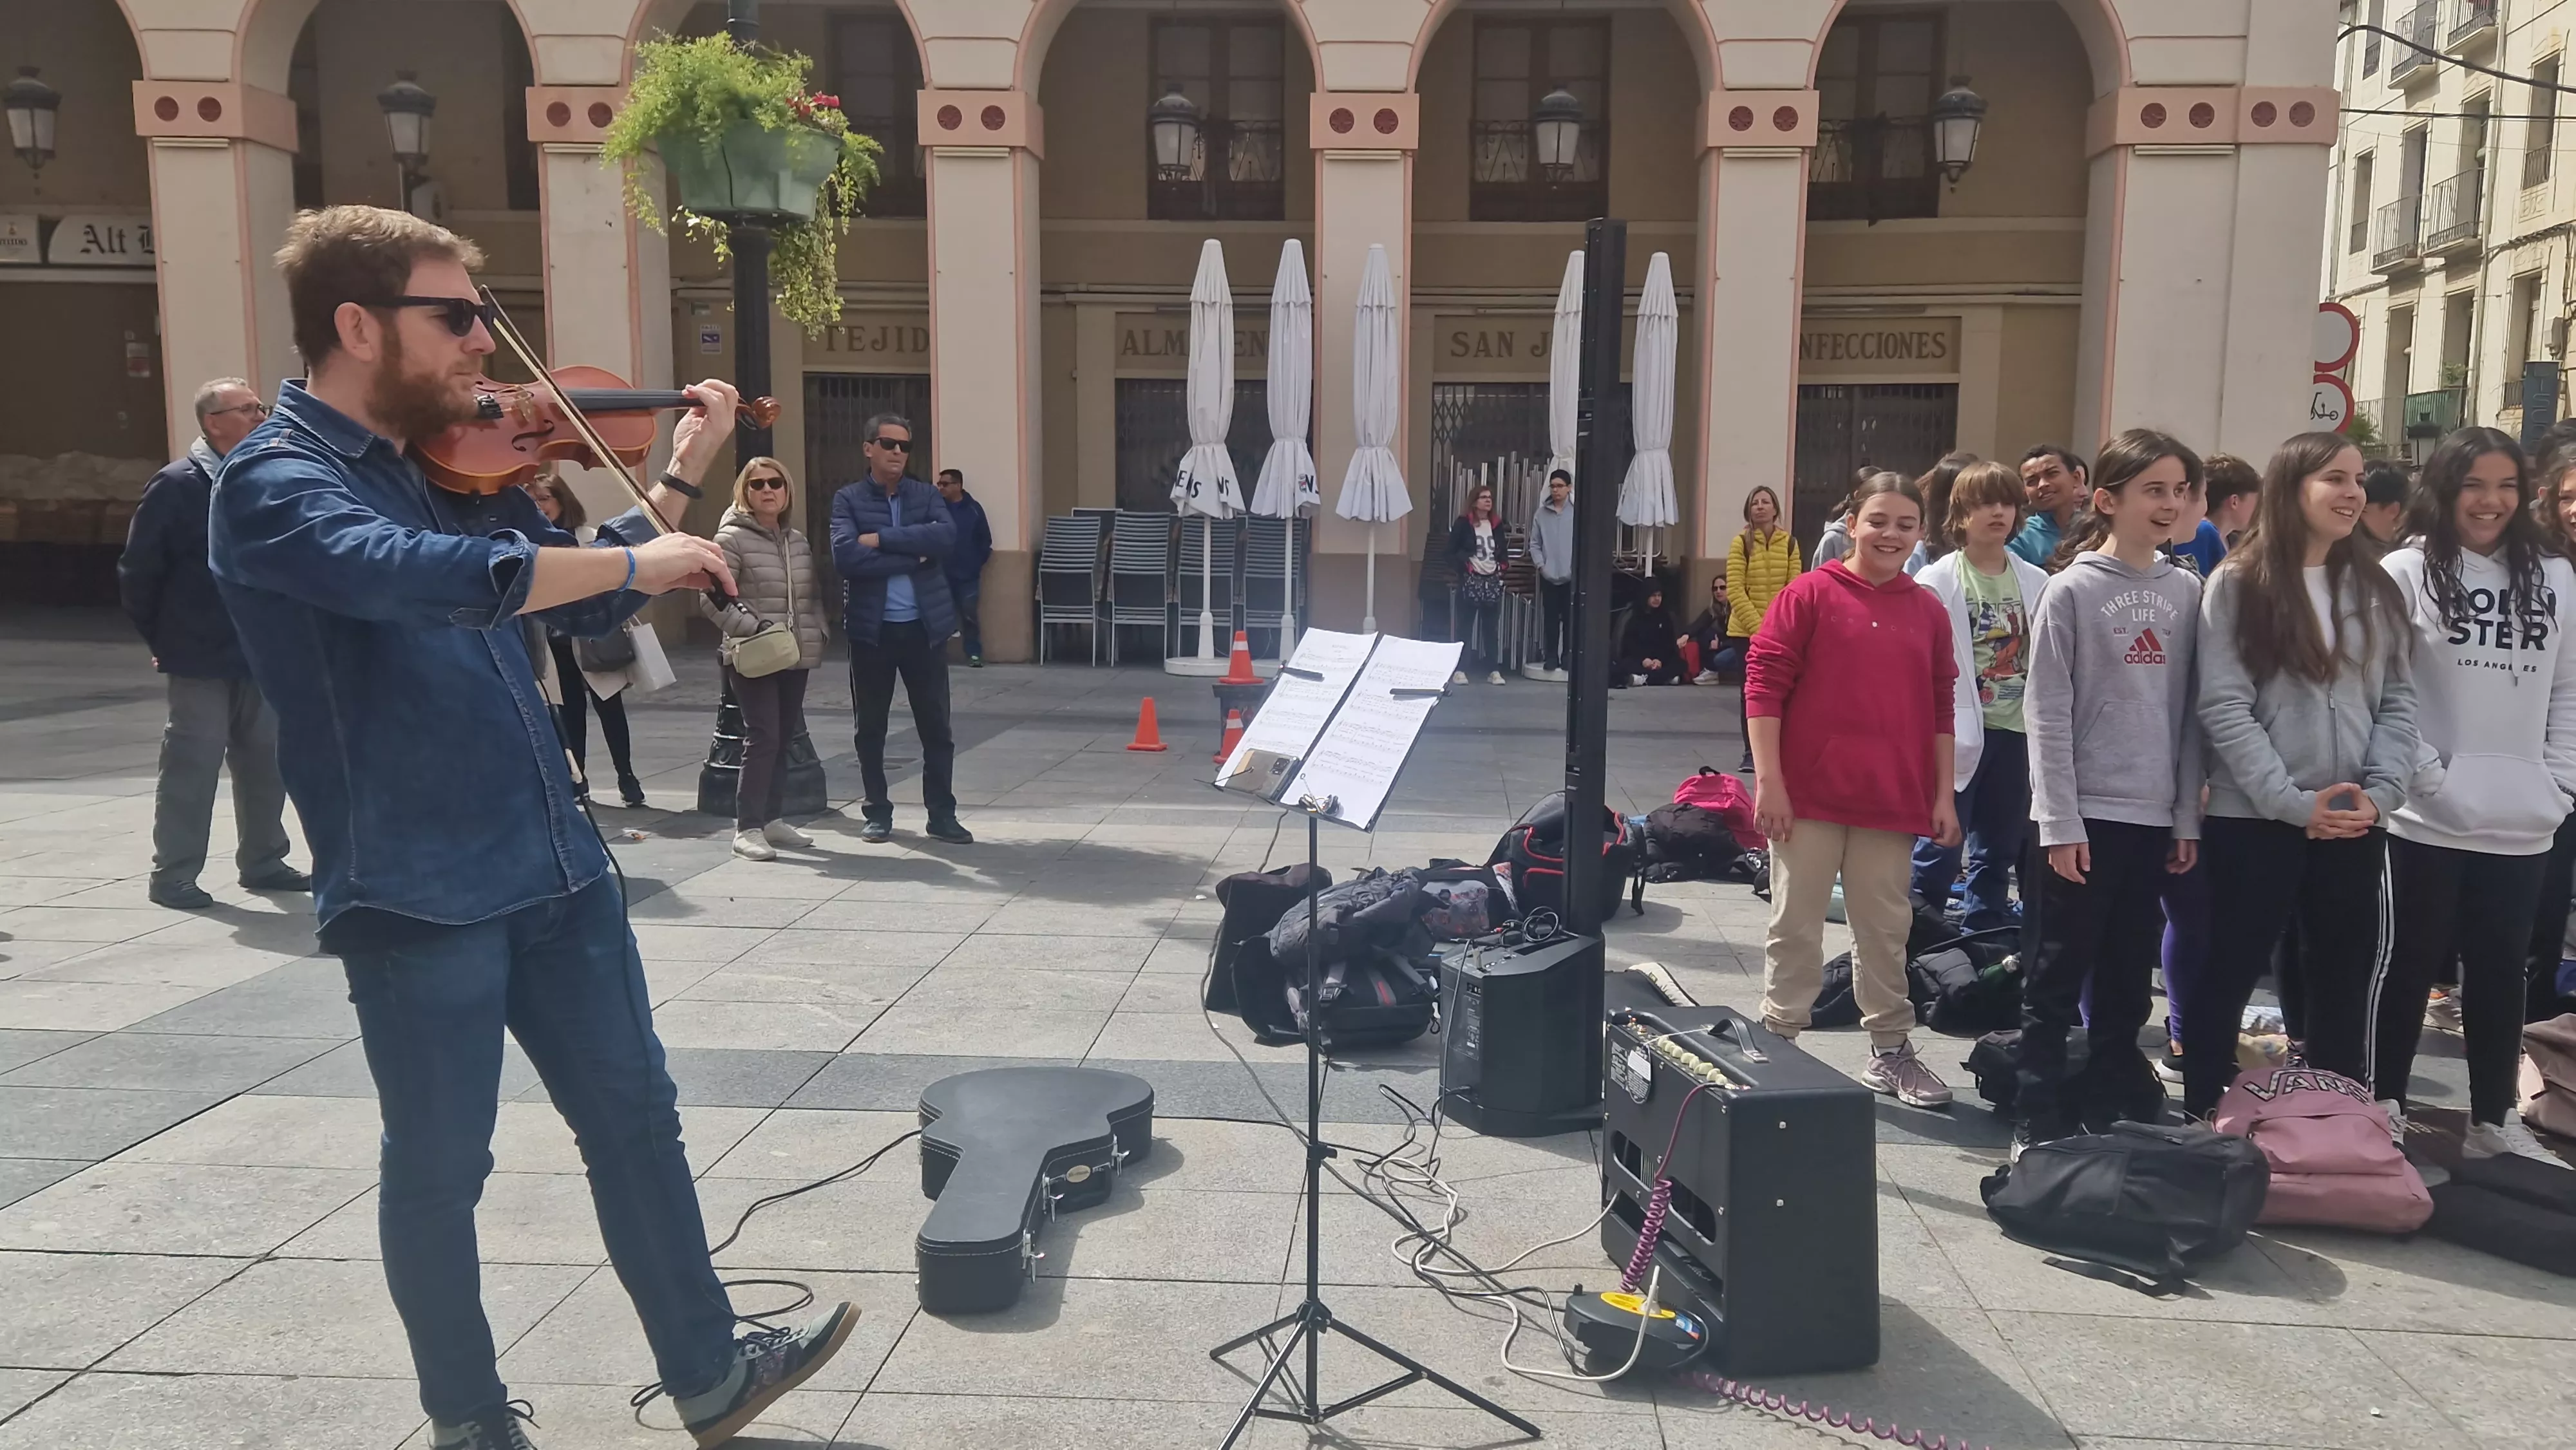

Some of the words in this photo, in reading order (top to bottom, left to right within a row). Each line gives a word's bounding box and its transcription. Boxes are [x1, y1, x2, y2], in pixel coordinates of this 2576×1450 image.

[80, 224, 127, 254] Alt
[1450, 330, 1515, 358] SAN
[2101, 590, 2139, 617] THREE
[2143, 589, 2179, 621] STRIPE
[2132, 608, 2156, 622] LIFE
[2448, 616, 2548, 651] STER
[2458, 658, 2479, 667] LOS
[2484, 661, 2537, 672] ANGEES
[2242, 1067, 2372, 1107] VANS
